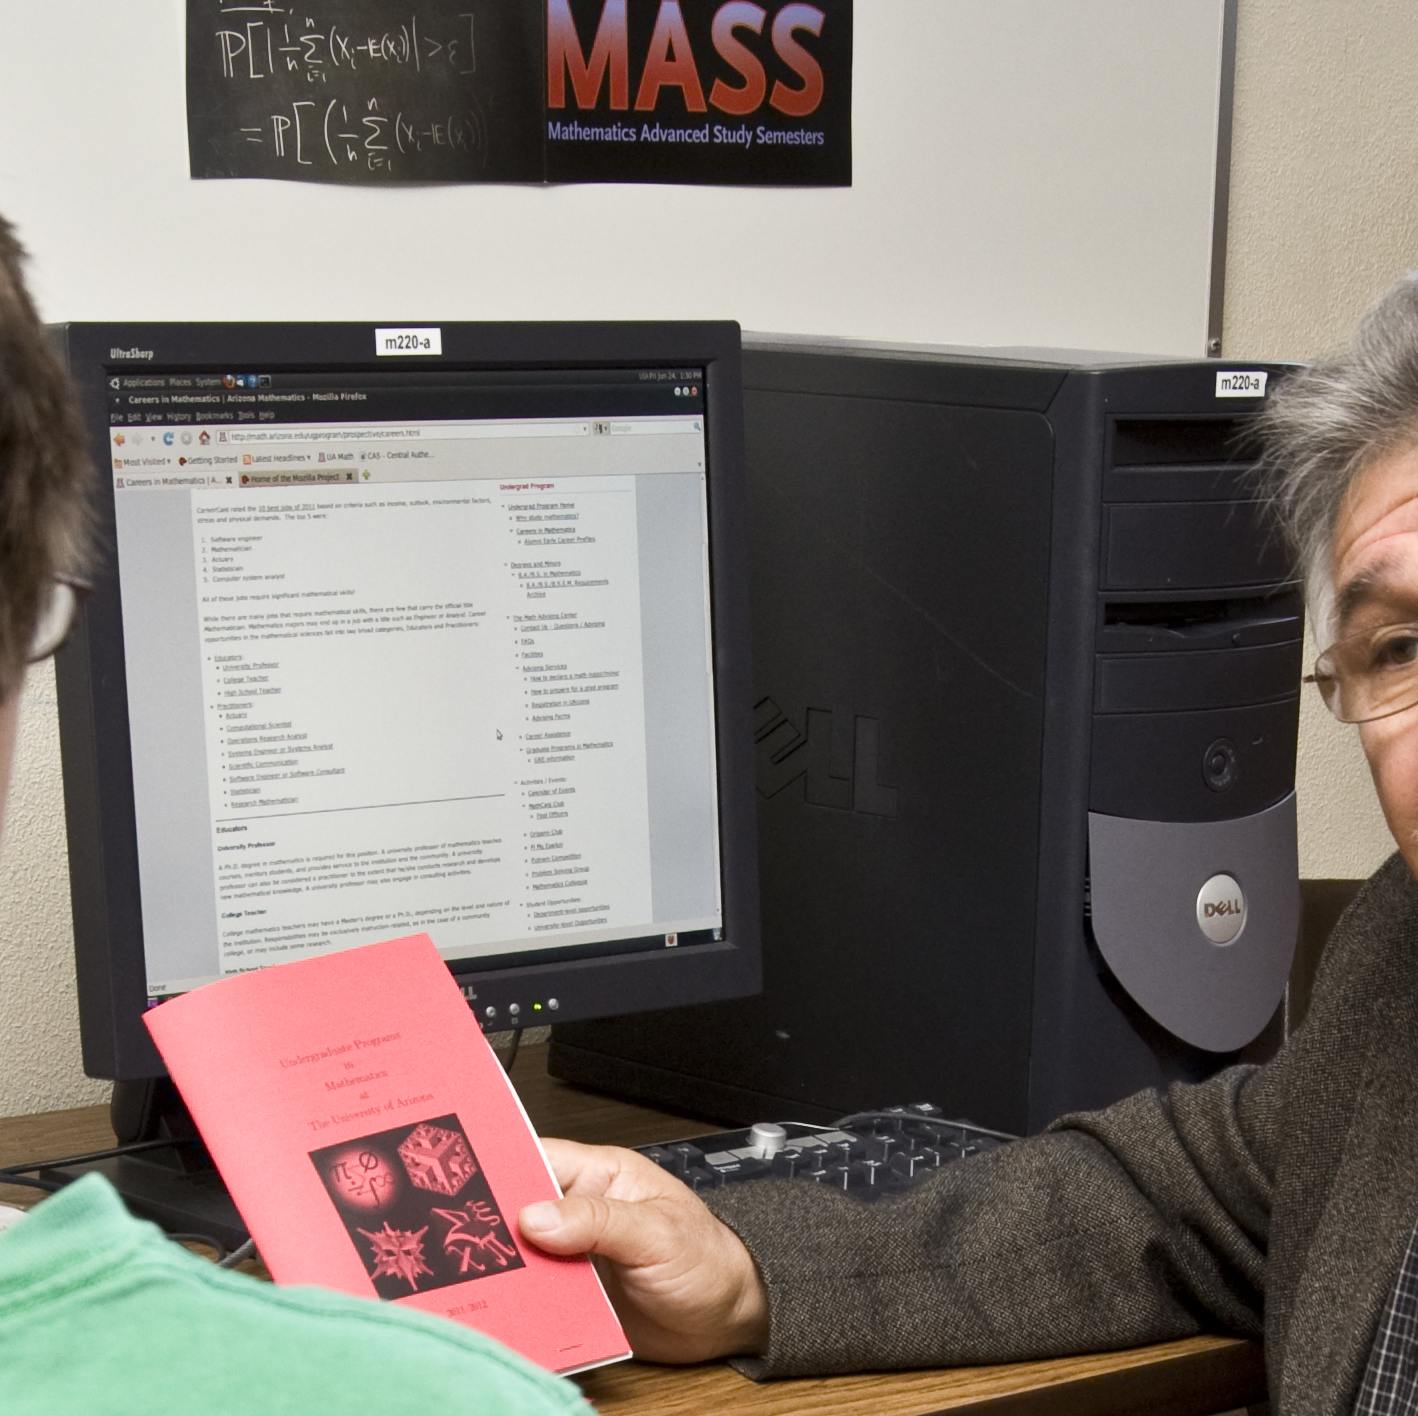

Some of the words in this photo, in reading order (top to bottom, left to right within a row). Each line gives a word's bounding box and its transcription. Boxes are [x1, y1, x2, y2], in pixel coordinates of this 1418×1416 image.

[547, 0, 826, 117] MASS
[547, 121, 636, 142] Mathematics
[640, 122, 709, 143] Advanced
[713, 125, 753, 149] Study
[756, 126, 825, 146] Semesters
[385, 334, 431, 350] m220-a
[110, 348, 154, 361] UltraSharp
[122, 378, 165, 388] Applications
[168, 377, 191, 386] Places
[195, 377, 221, 387] System
[1221, 375, 1260, 391] m220-a
[128, 395, 160, 404] Careers
[170, 394, 220, 403] Mathematics
[226, 394, 256, 402] Arizona
[257, 393, 305, 402] Mathematics
[312, 393, 339, 401] Mozilla
[339, 392, 367, 400] Firefox
[109, 412, 124, 422] File
[126, 412, 142, 421] Edit
[144, 412, 163, 421] View
[165, 411, 192, 422] History
[194, 410, 234, 420] Bookmarks
[237, 410, 255, 419] Tools
[257, 410, 275, 420] Help
[122, 458, 141, 466] Most
[141, 457, 166, 466] Visited
[187, 456, 213, 466] Getting
[213, 455, 238, 464] Started
[251, 454, 272, 463] Latest
[272, 453, 305, 462] Headlines
[326, 452, 336, 461] UA
[337, 452, 354, 460] Math
[367, 451, 381, 460] CAS
[386, 451, 410, 459] Central
[125, 478, 153, 486] Careers
[161, 476, 206, 485] Mathematics
[250, 474, 271, 482] Home
[279, 474, 291, 482] the
[292, 473, 316, 481] Mozilla
[316, 472, 339, 482] Project
[1203, 899, 1241, 918] DELL
[279, 1043, 353, 1069] Undergraduate
[353, 1032, 402, 1050] Programs
[324, 1070, 389, 1092] Mathematics
[307, 1119, 331, 1131] The
[331, 1106, 381, 1126] University
[383, 1100, 395, 1111] of
[397, 1093, 435, 1109] Arizona
